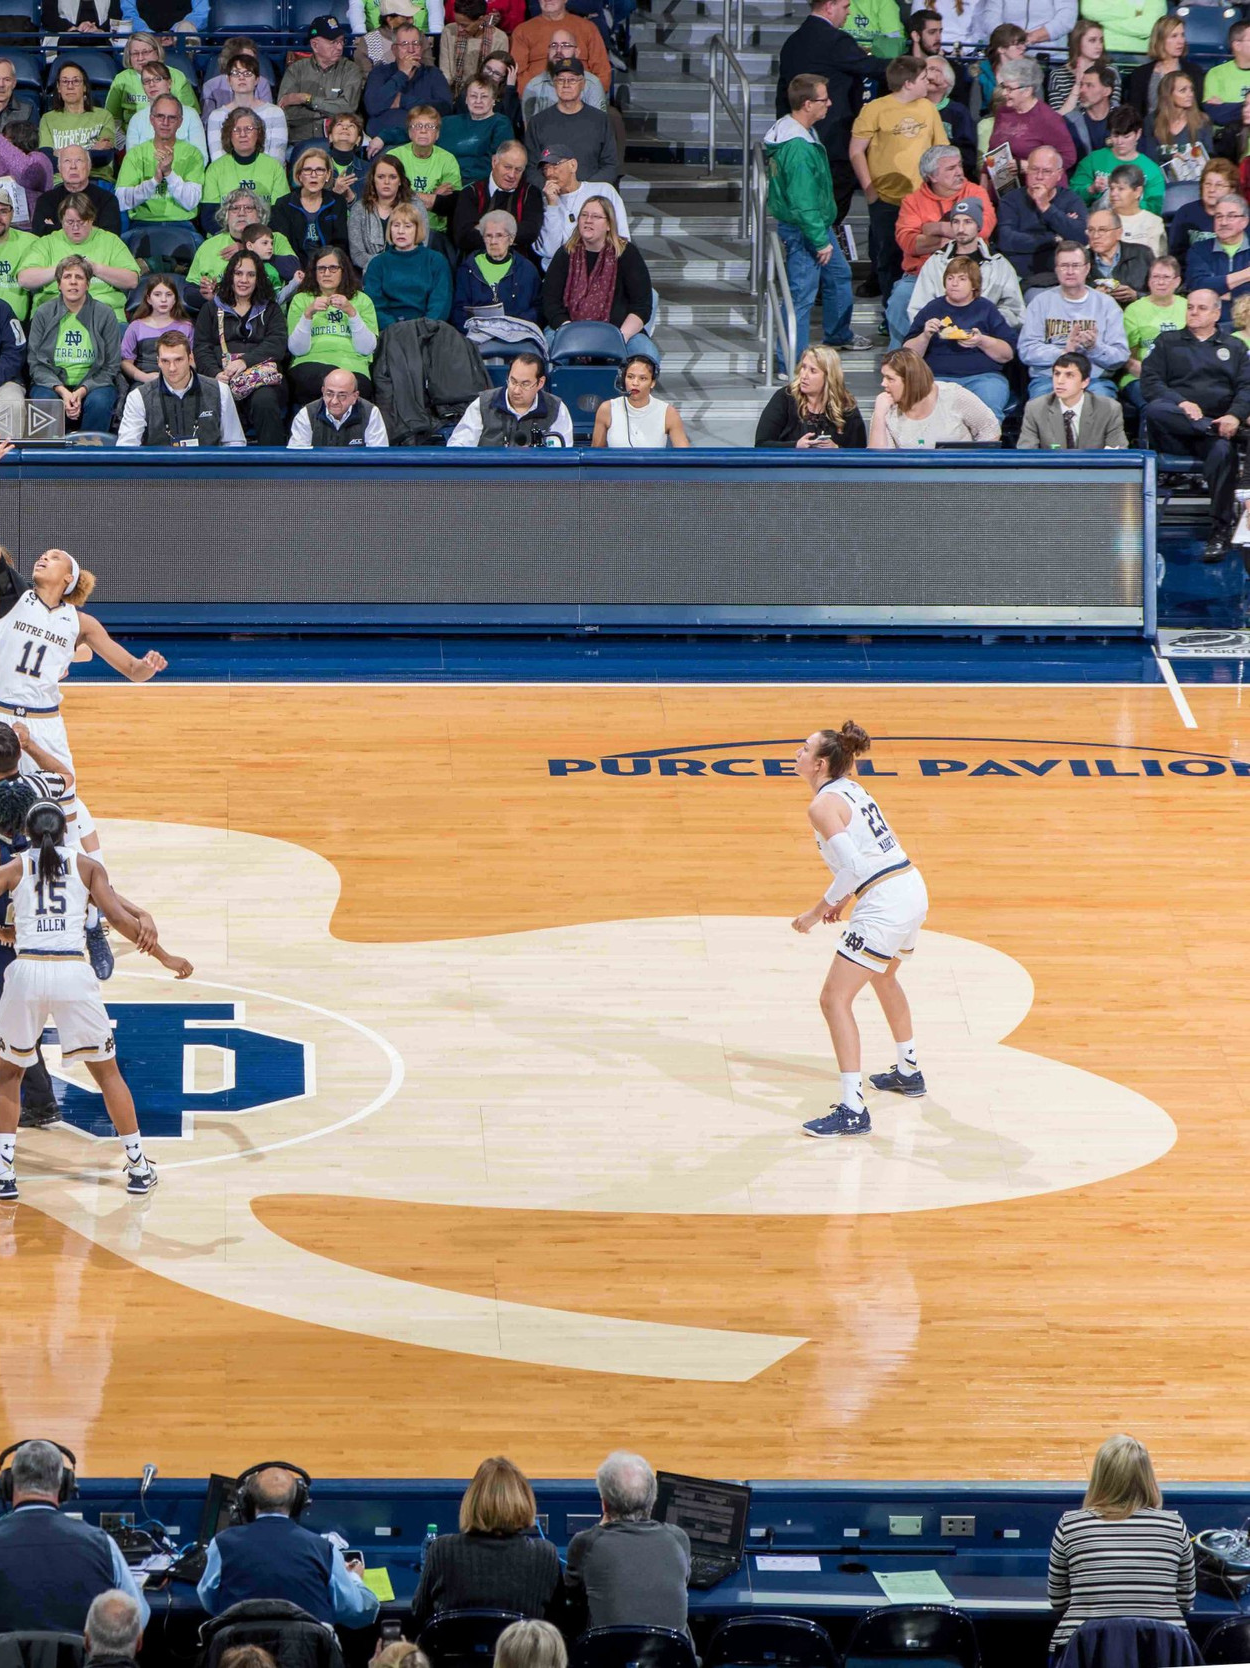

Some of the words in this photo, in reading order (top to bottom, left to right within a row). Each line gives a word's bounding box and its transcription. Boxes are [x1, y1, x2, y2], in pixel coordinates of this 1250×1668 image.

[13, 620, 44, 638] NOTRE
[44, 630, 69, 648] DAME
[15, 641, 48, 679] 11
[549, 757, 898, 777] PURCEL
[861, 803, 888, 838] 23
[35, 881, 67, 915] 15
[36, 918, 66, 933] ALLEN
